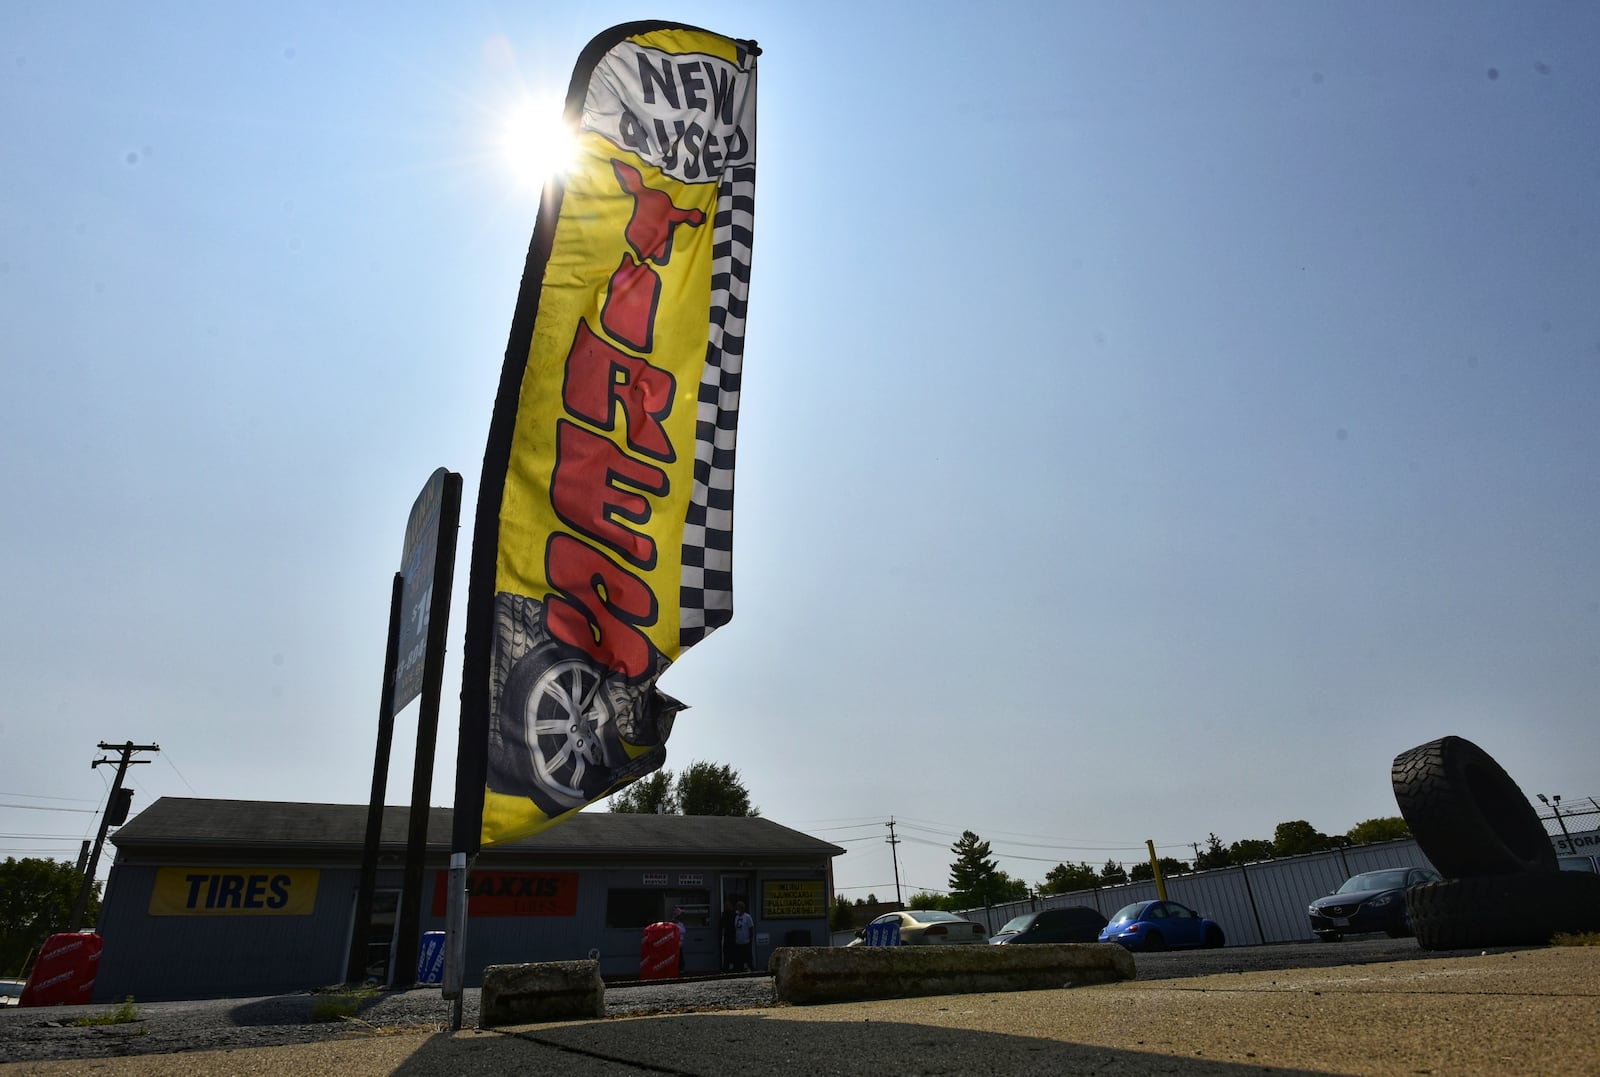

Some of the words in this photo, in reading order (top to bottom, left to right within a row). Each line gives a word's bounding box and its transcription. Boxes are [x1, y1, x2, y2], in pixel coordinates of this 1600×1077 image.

[636, 51, 736, 125] NEW
[653, 118, 749, 179] USED
[542, 157, 707, 686] TIRES
[185, 874, 291, 909] TIRES
